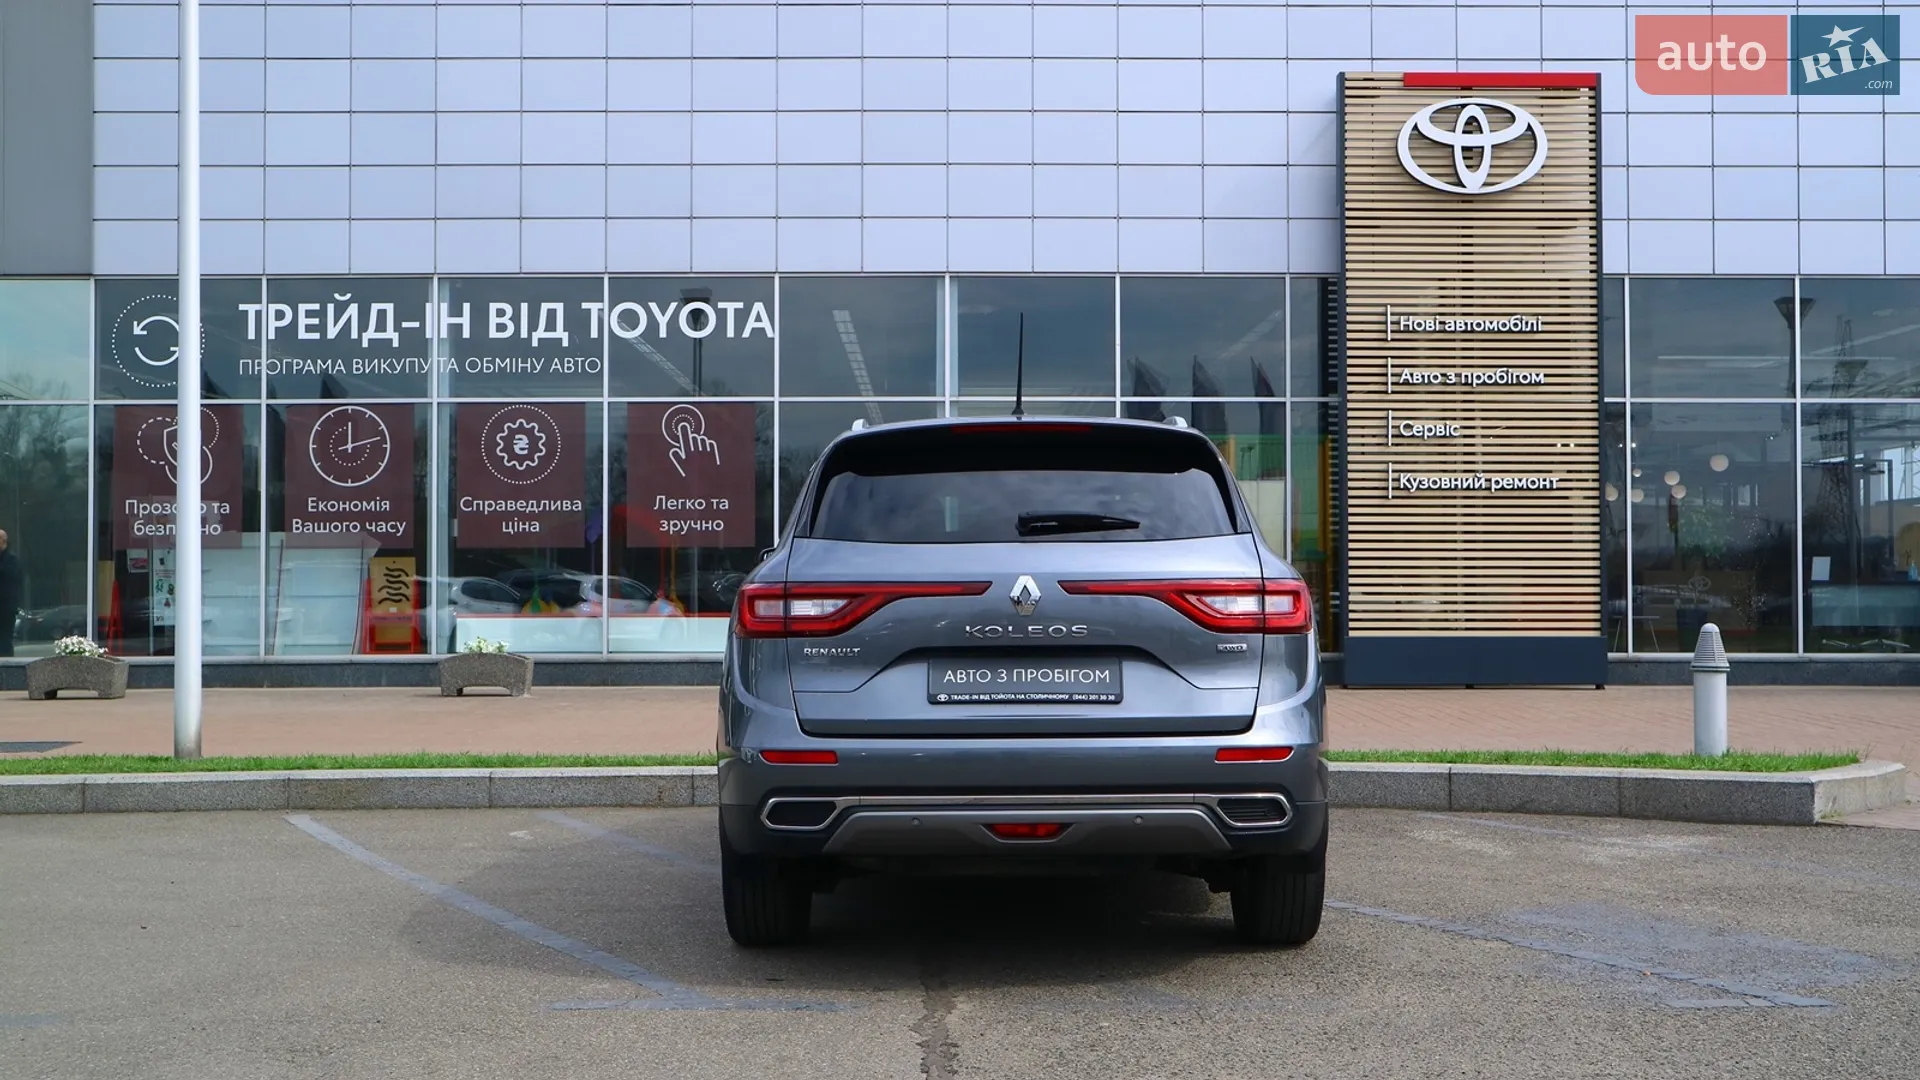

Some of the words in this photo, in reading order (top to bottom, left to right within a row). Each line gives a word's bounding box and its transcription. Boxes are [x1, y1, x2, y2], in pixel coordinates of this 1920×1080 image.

[238, 292, 471, 348] ТРЕЙД-ІН
[488, 302, 569, 347] ВІД
[581, 301, 775, 339] TOYOTA
[1400, 315, 1440, 331] Нові
[1445, 315, 1543, 331] автомобілі
[239, 358, 346, 376] ПРОГРАМА
[352, 357, 432, 376] ВИКУПУ
[438, 358, 460, 374] ТА
[465, 357, 545, 374] ОБМІНУ
[549, 357, 601, 374] АВТО
[1400, 368, 1442, 384] Авто
[1446, 371, 1456, 384] з
[1461, 368, 1545, 387] пробігом
[1400, 420, 1461, 440] Сервіс
[1400, 473, 1486, 492] Кузовний
[1491, 476, 1559, 493] ремонт
[211, 502, 230, 514] та
[308, 496, 390, 512] Економія
[460, 496, 582, 515] Справедлива
[653, 495, 706, 510] Легко
[711, 498, 729, 510] та
[134, 520, 221, 535] безпно
[292, 518, 360, 533] Вашого
[366, 521, 406, 536] часу
[502, 517, 540, 535] ціна
[659, 519, 724, 535] зручно
[965, 624, 1088, 638] KOLEOS
[803, 647, 861, 657] RENAULT
[943, 670, 991, 683] АВТО
[1013, 669, 1110, 683] ПРОБІГОМ
